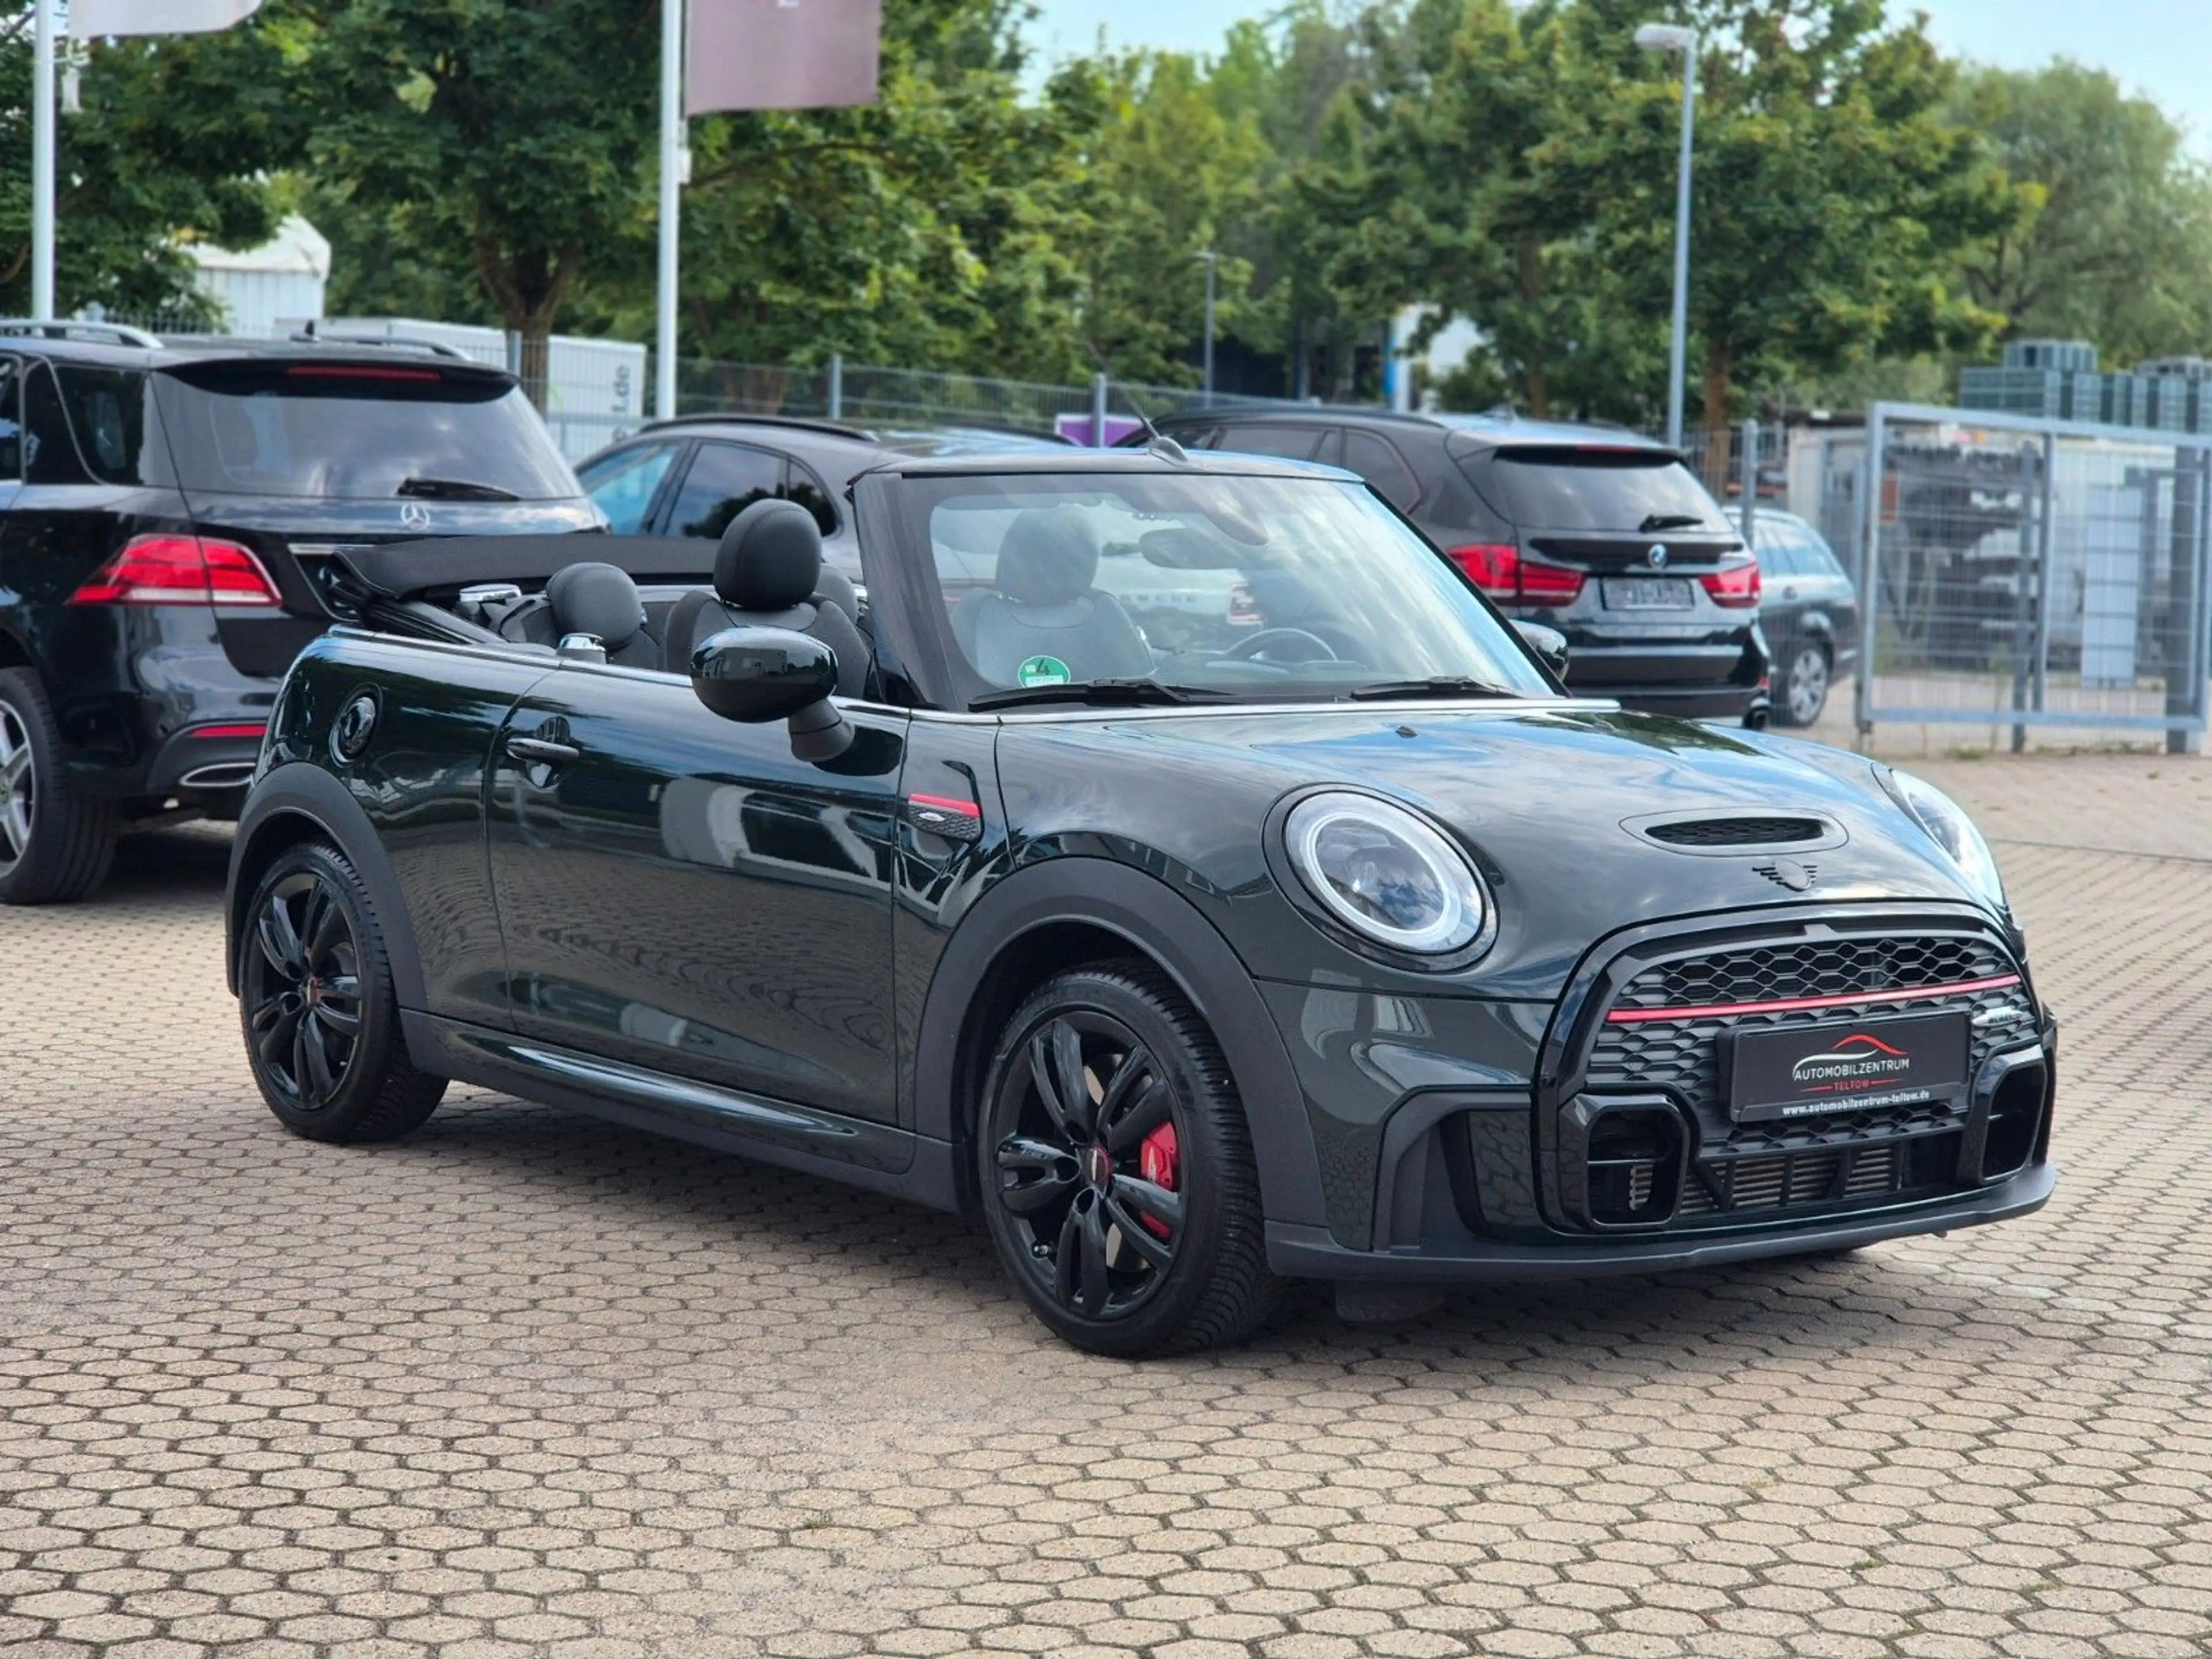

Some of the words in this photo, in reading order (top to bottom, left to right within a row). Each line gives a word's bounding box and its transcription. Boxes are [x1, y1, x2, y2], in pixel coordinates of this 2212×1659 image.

[1036, 658, 1050, 676] 4
[1794, 1058, 1910, 1082] AUTOMOBILZENTRUM
[1833, 1078, 1870, 1091] TELTOW
[1782, 1089, 1930, 1116] www.automobilzentrum-teltow.de
